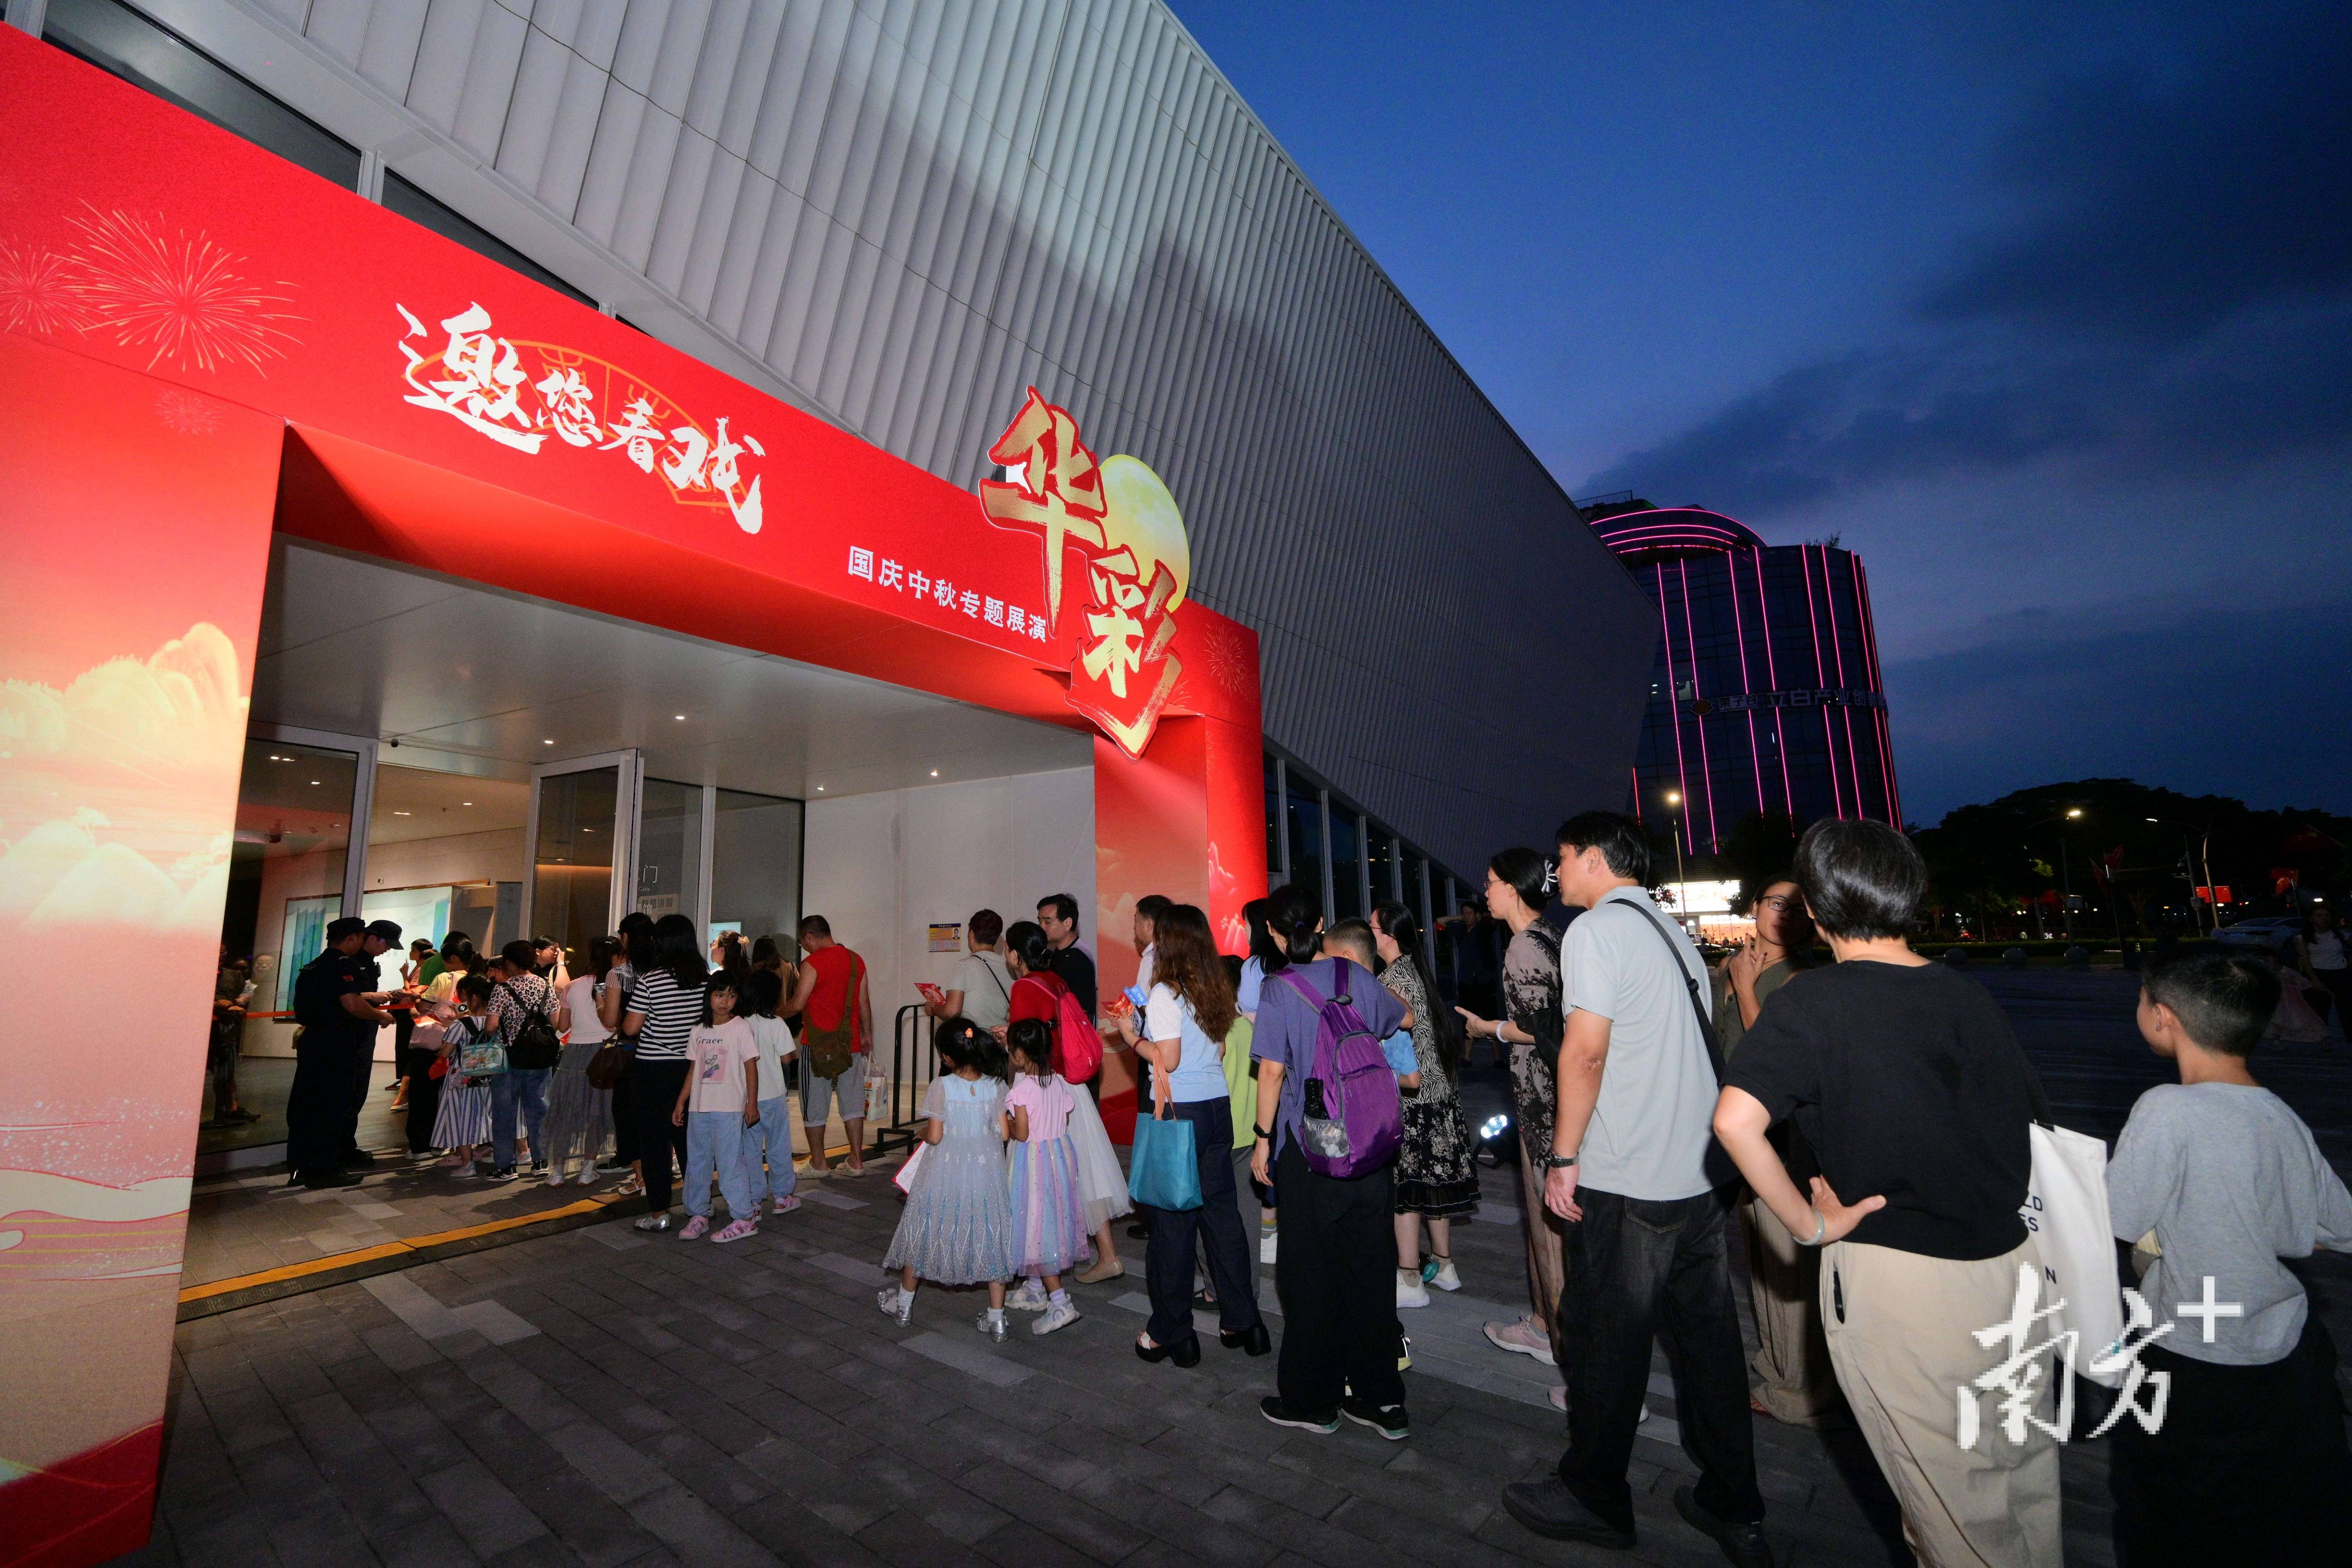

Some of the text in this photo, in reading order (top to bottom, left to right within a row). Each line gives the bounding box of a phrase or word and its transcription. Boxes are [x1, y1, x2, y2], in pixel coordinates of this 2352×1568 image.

[396, 301, 766, 534] 邀您看戏
[848, 545, 1047, 643] 国庆中秋专题展演
[982, 391, 1183, 755] 华彩
[1719, 694, 1757, 708] 栗子谷
[638, 865, 658, 884] 门
